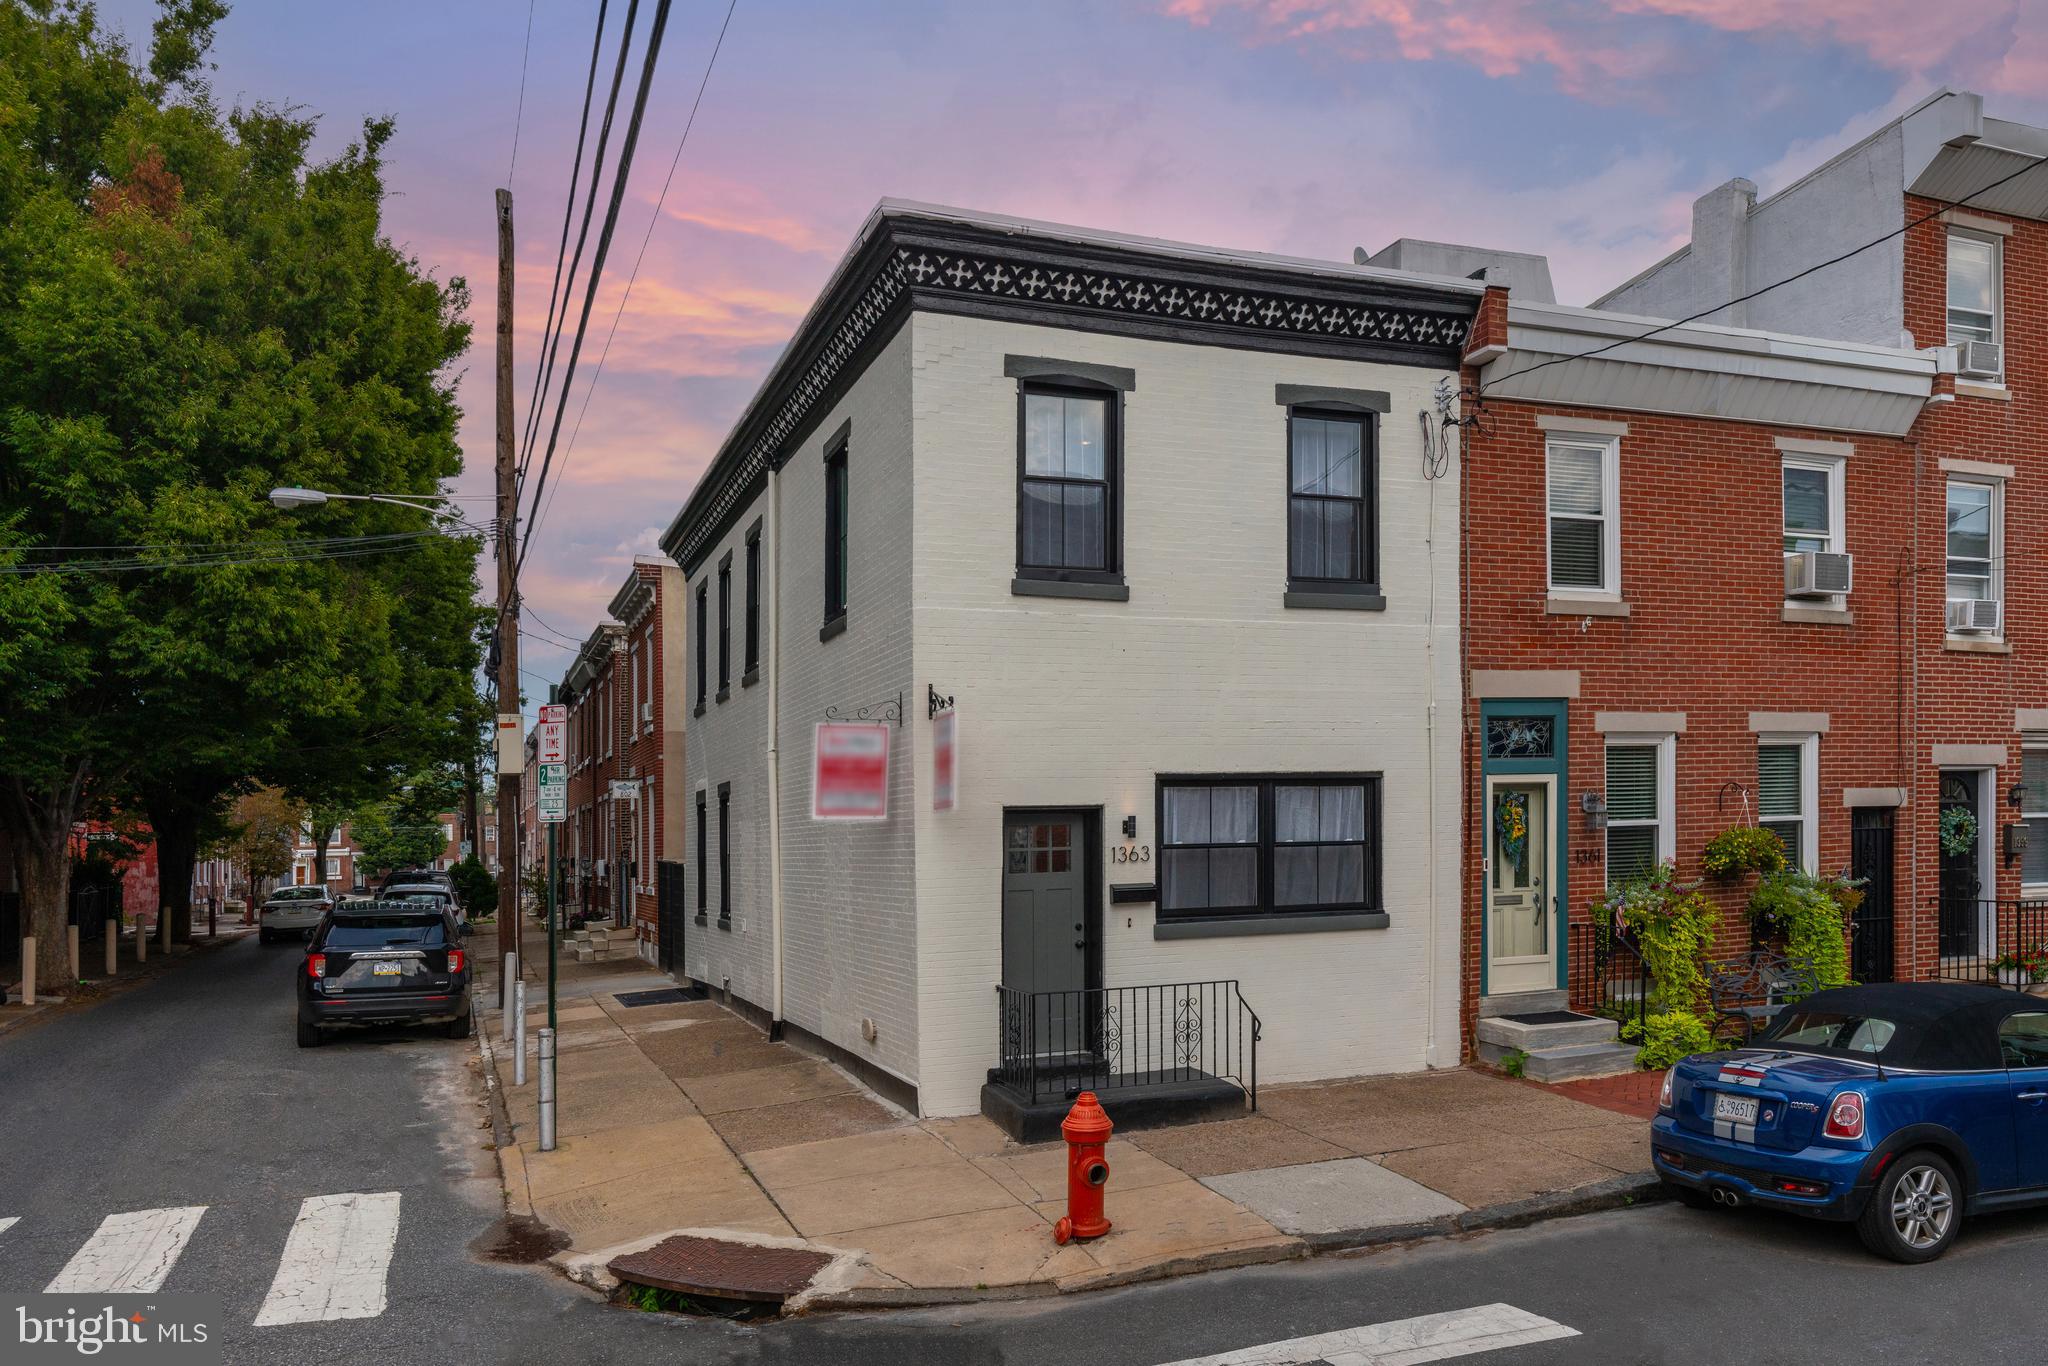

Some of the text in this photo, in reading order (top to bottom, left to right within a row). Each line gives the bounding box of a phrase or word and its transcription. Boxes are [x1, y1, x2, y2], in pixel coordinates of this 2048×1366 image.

[548, 710, 564, 719] PARKING
[546, 725, 559, 736] ANY
[546, 738, 559, 749] TIME
[541, 768, 546, 783] 2
[1111, 846, 1150, 864] 1363
[1576, 848, 1601, 864] 1361
[1790, 1101, 1814, 1110] COOPER
